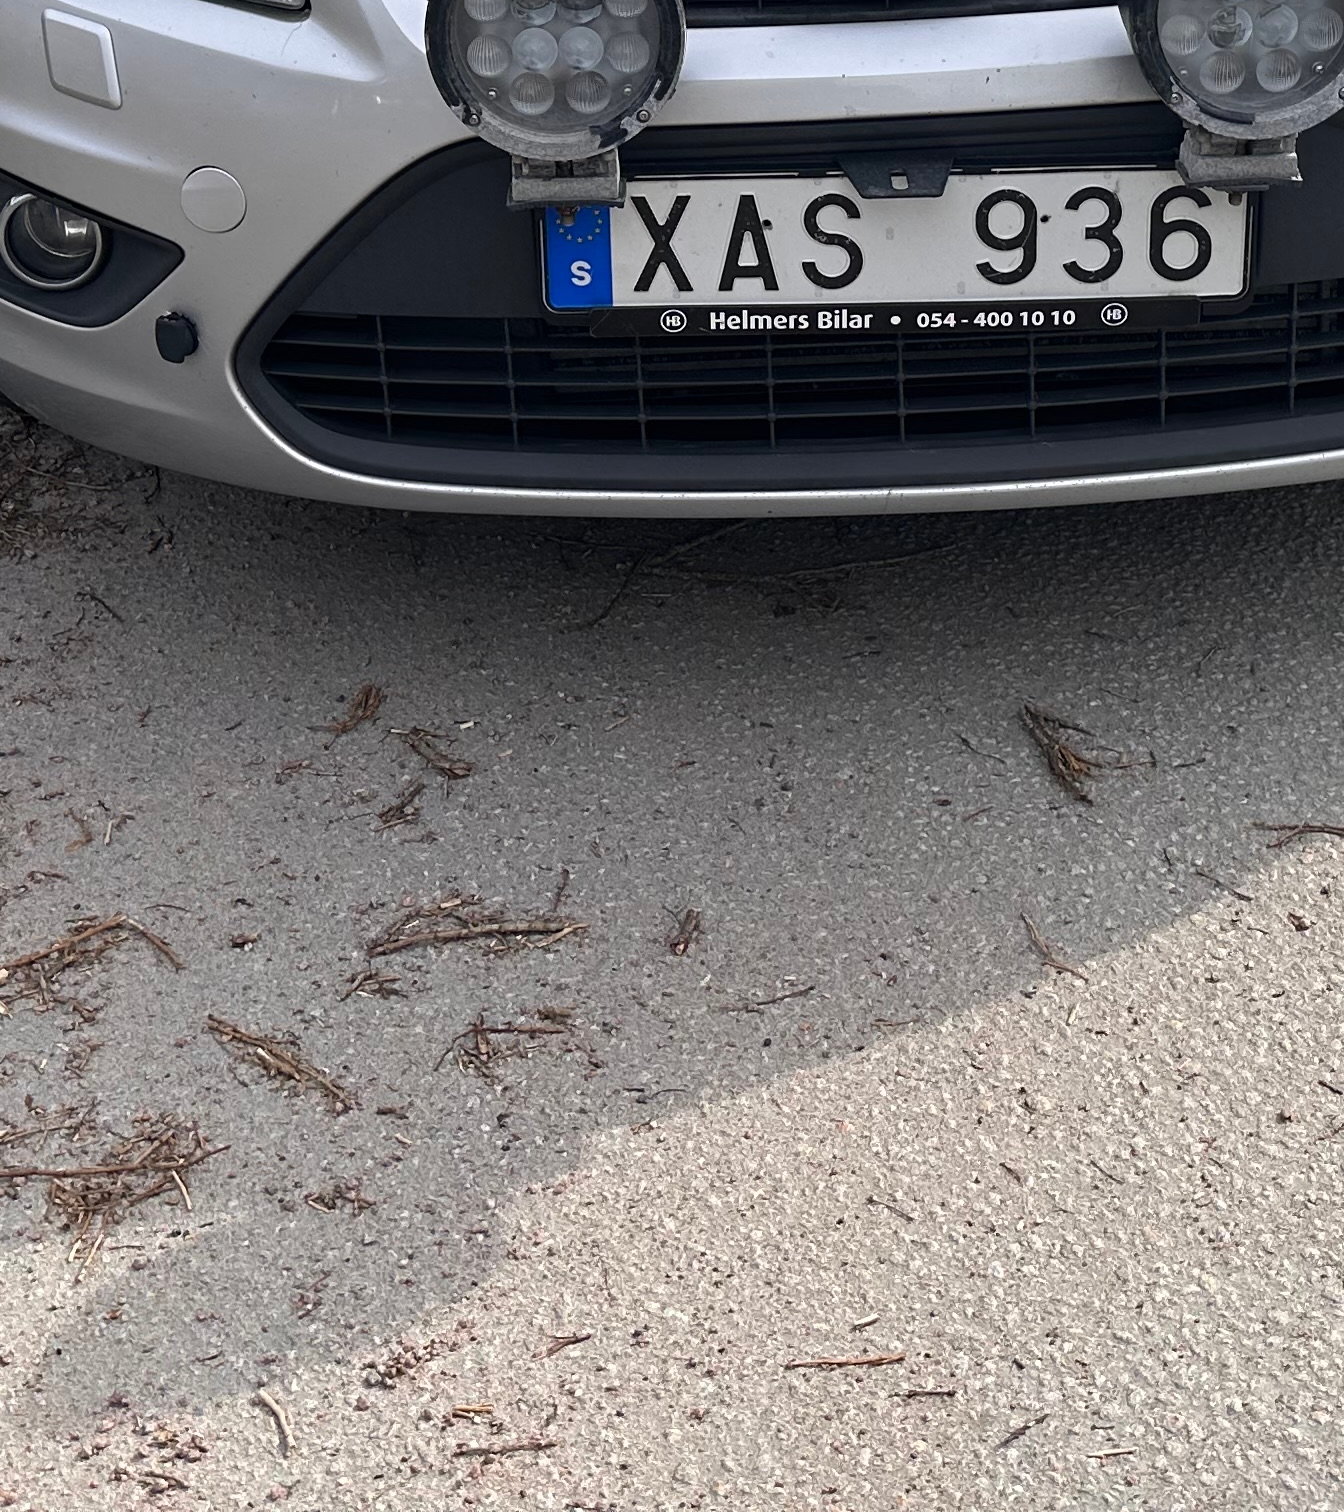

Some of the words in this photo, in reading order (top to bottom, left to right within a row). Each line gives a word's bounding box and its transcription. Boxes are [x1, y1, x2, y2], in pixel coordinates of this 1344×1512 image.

[630, 193, 864, 292] XAS
[975, 185, 1212, 285] 936
[570, 260, 592, 286] S
[709, 309, 809, 330] Helmers
[817, 309, 874, 329] Bilar
[916, 312, 956, 328] 054
[973, 311, 1013, 328] 400
[1019, 310, 1045, 327] 10
[1051, 309, 1076, 326] 10
